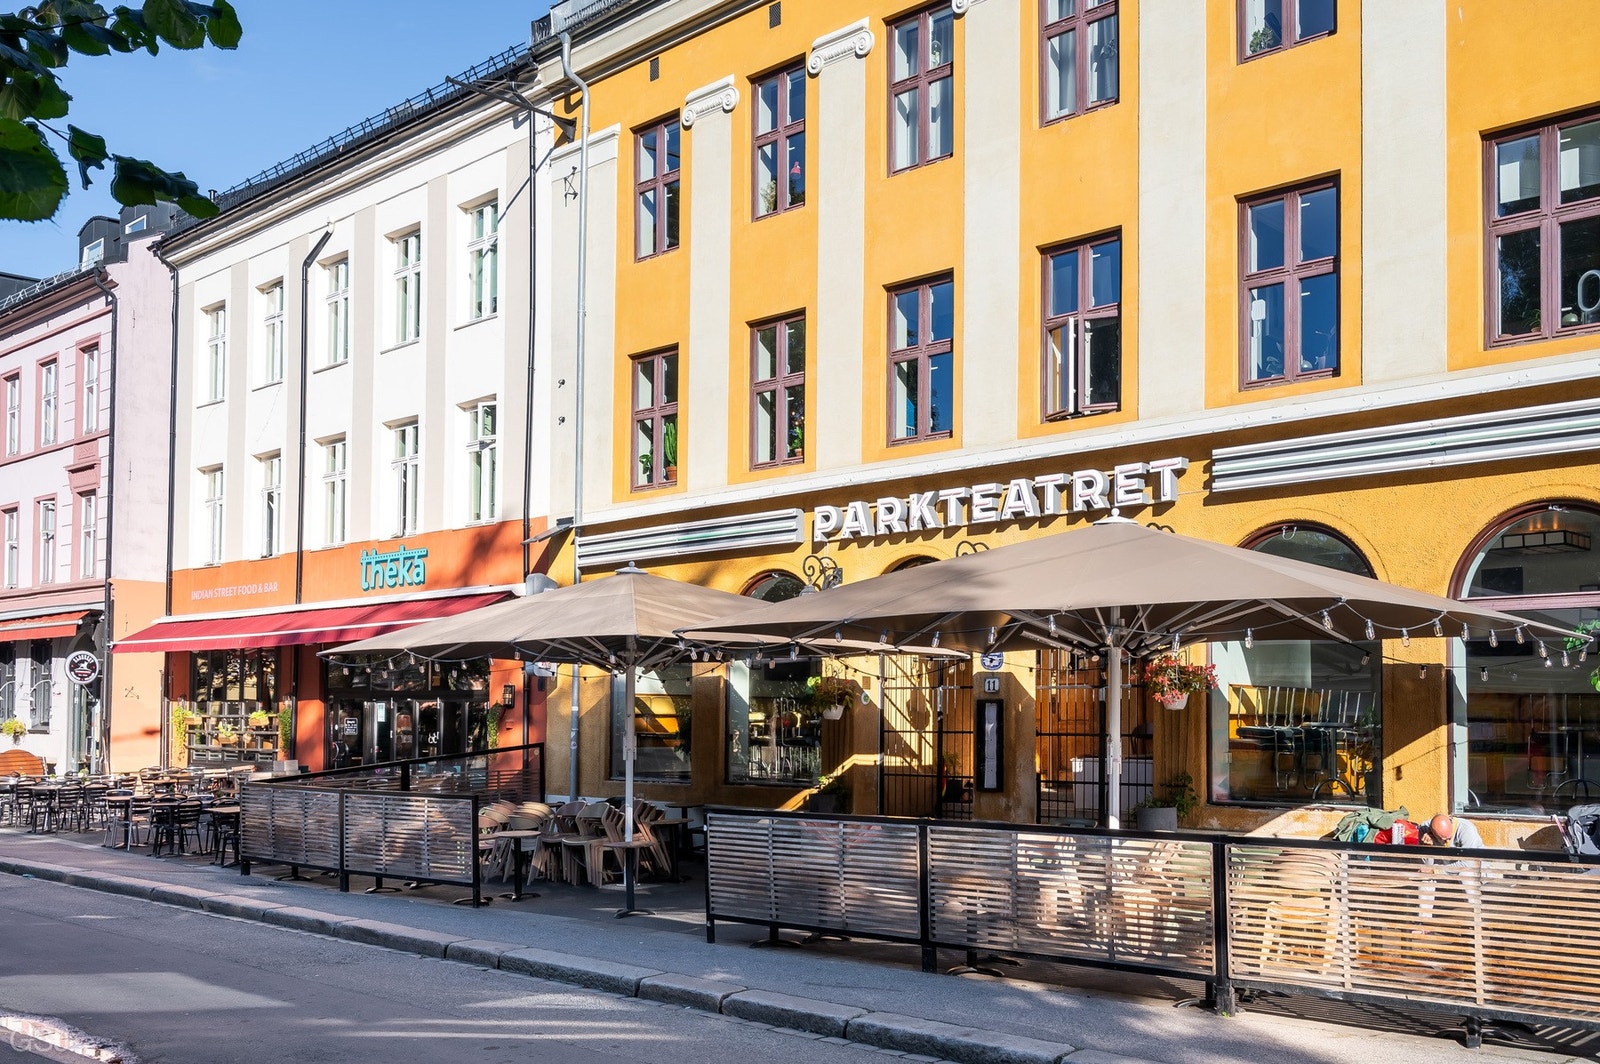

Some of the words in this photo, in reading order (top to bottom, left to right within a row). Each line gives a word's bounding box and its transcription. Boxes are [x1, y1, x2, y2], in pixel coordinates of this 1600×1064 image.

[813, 456, 1189, 542] PARKTEATRET
[360, 544, 428, 591] theka
[191, 588, 213, 601] INDIAN
[214, 585, 237, 598] STREET
[238, 583, 257, 596] FOOD
[258, 583, 263, 594] &
[264, 581, 278, 593] BAR
[986, 680, 996, 691] 11
